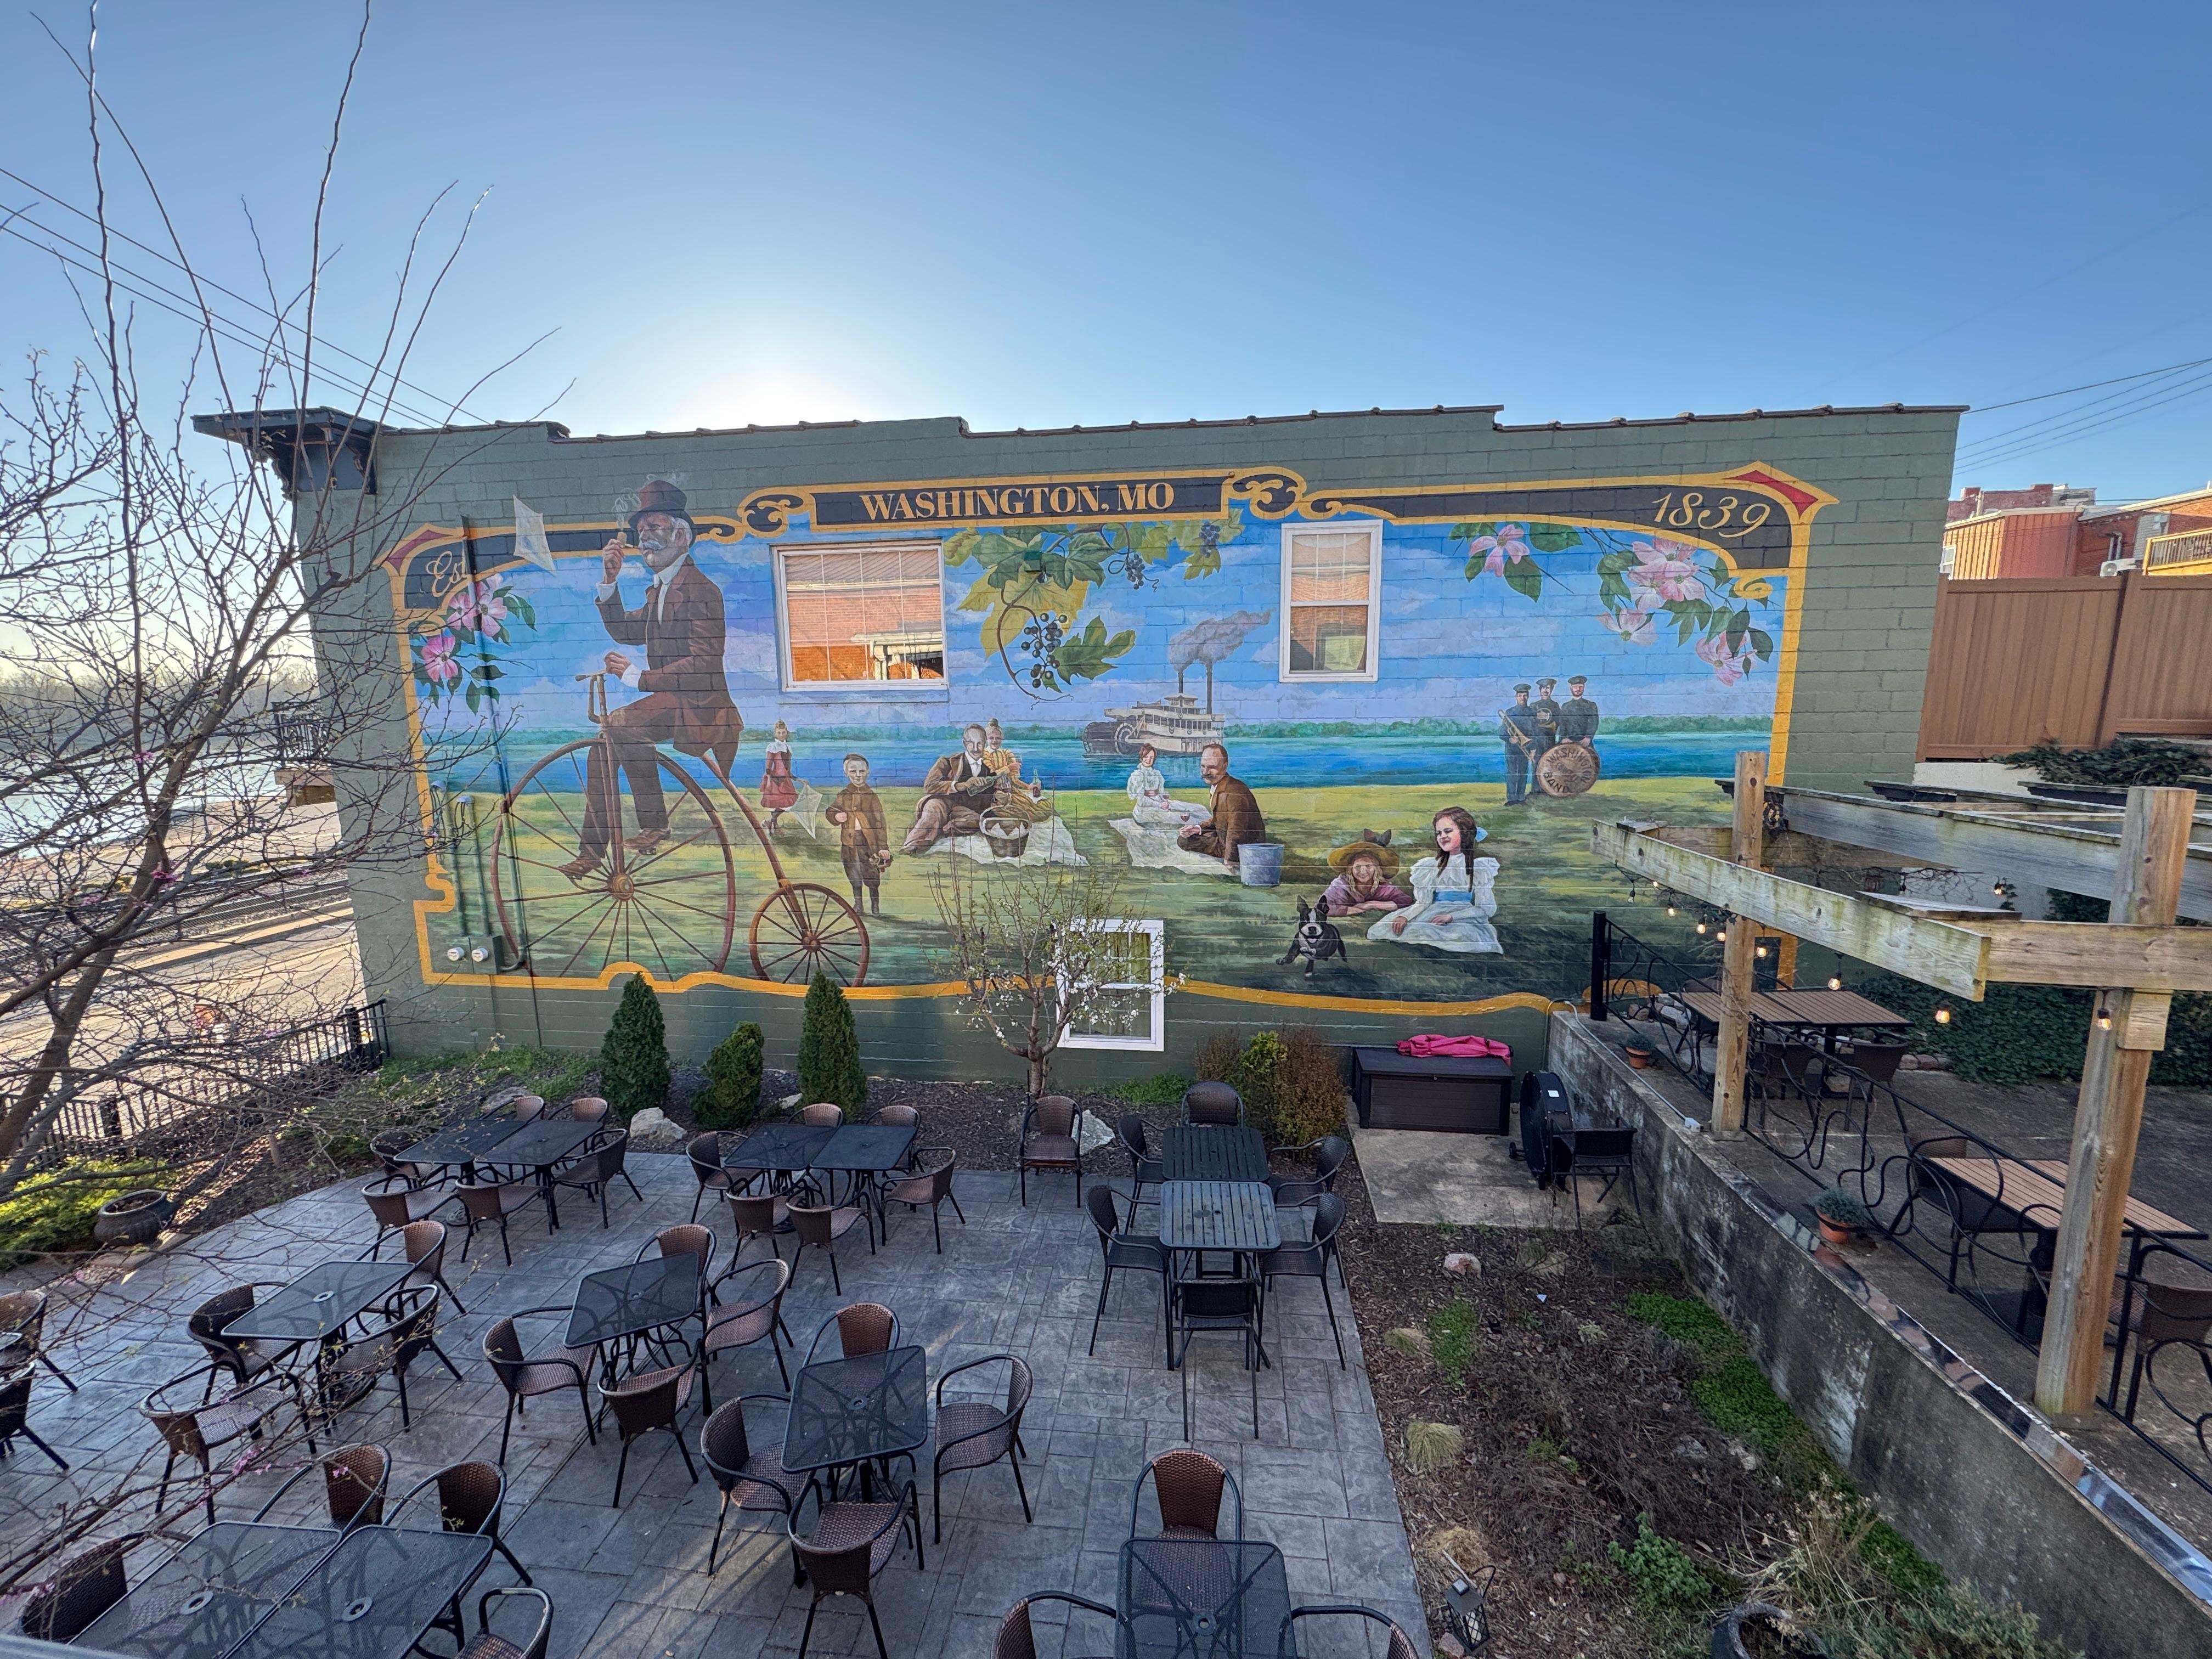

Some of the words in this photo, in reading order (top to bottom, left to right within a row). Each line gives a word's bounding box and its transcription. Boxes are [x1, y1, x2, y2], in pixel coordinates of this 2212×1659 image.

[859, 486, 1109, 521] WASHINGTON,
[1117, 482, 1174, 510] MO
[1651, 492, 1770, 538] 1839
[1543, 771, 1570, 793] BAND
[1547, 748, 1592, 783] WASHINGTON
